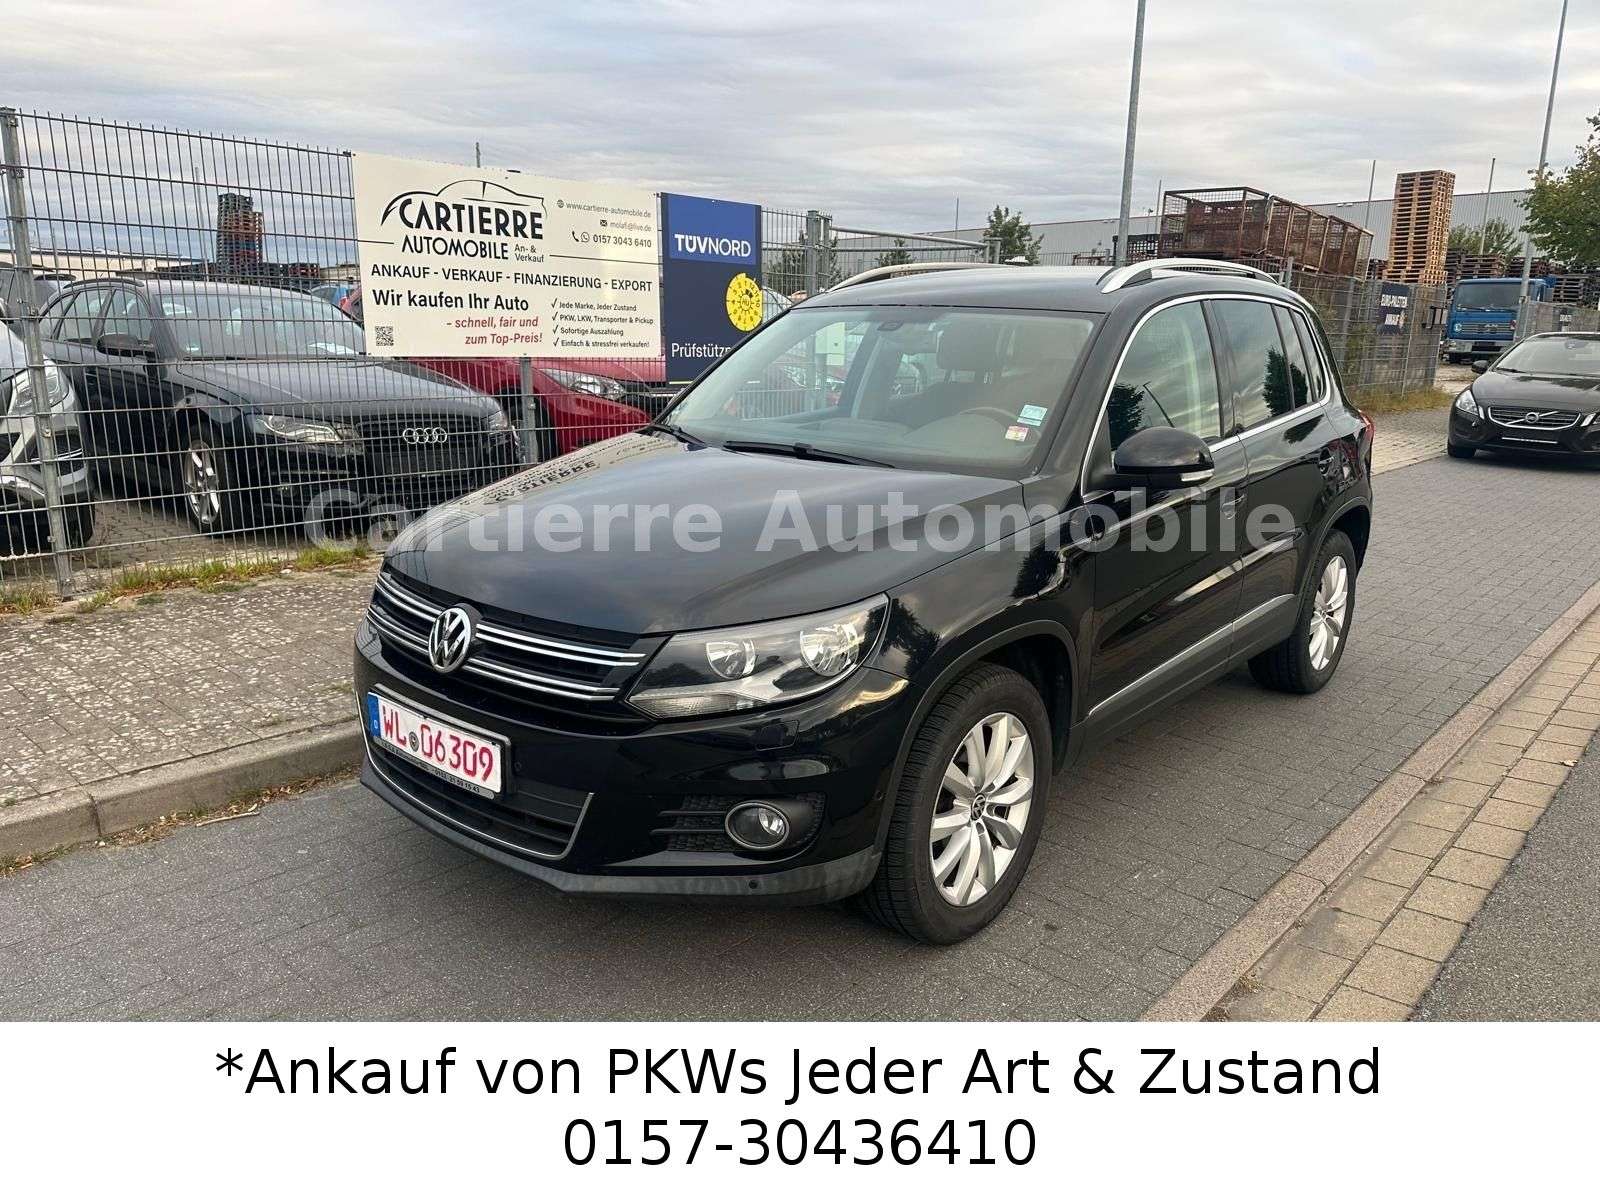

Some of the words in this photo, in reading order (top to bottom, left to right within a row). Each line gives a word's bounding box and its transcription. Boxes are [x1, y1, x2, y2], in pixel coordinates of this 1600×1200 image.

[399, 198, 544, 240] CARTIERRE
[402, 235, 509, 260] AUTOMOBILE
[593, 234, 611, 244] 0157
[613, 236, 632, 246] 3043
[634, 238, 652, 248] 6410
[514, 244, 528, 253] An-
[530, 245, 537, 253] &
[515, 252, 545, 263] Verkauf
[371, 264, 430, 279] ANKAUF
[442, 268, 503, 283] VERKAUF
[514, 272, 602, 289] FINANZIERUNG
[611, 279, 653, 292] EXPORT
[372, 289, 402, 306] Wir
[407, 290, 464, 309] kaufen
[468, 293, 490, 309] Ihr
[494, 295, 529, 311] Auto
[613, 304, 637, 312] Zustand
[455, 316, 497, 329] schnell,
[499, 316, 517, 328] fair
[519, 316, 539, 327] und
[594, 316, 628, 325] Transporter
[635, 317, 654, 325] Pickup
[465, 335, 487, 345] zum
[490, 332, 543, 346] Top-Preis!
[382, 705, 407, 747] WL
[420, 723, 494, 782] 06309
